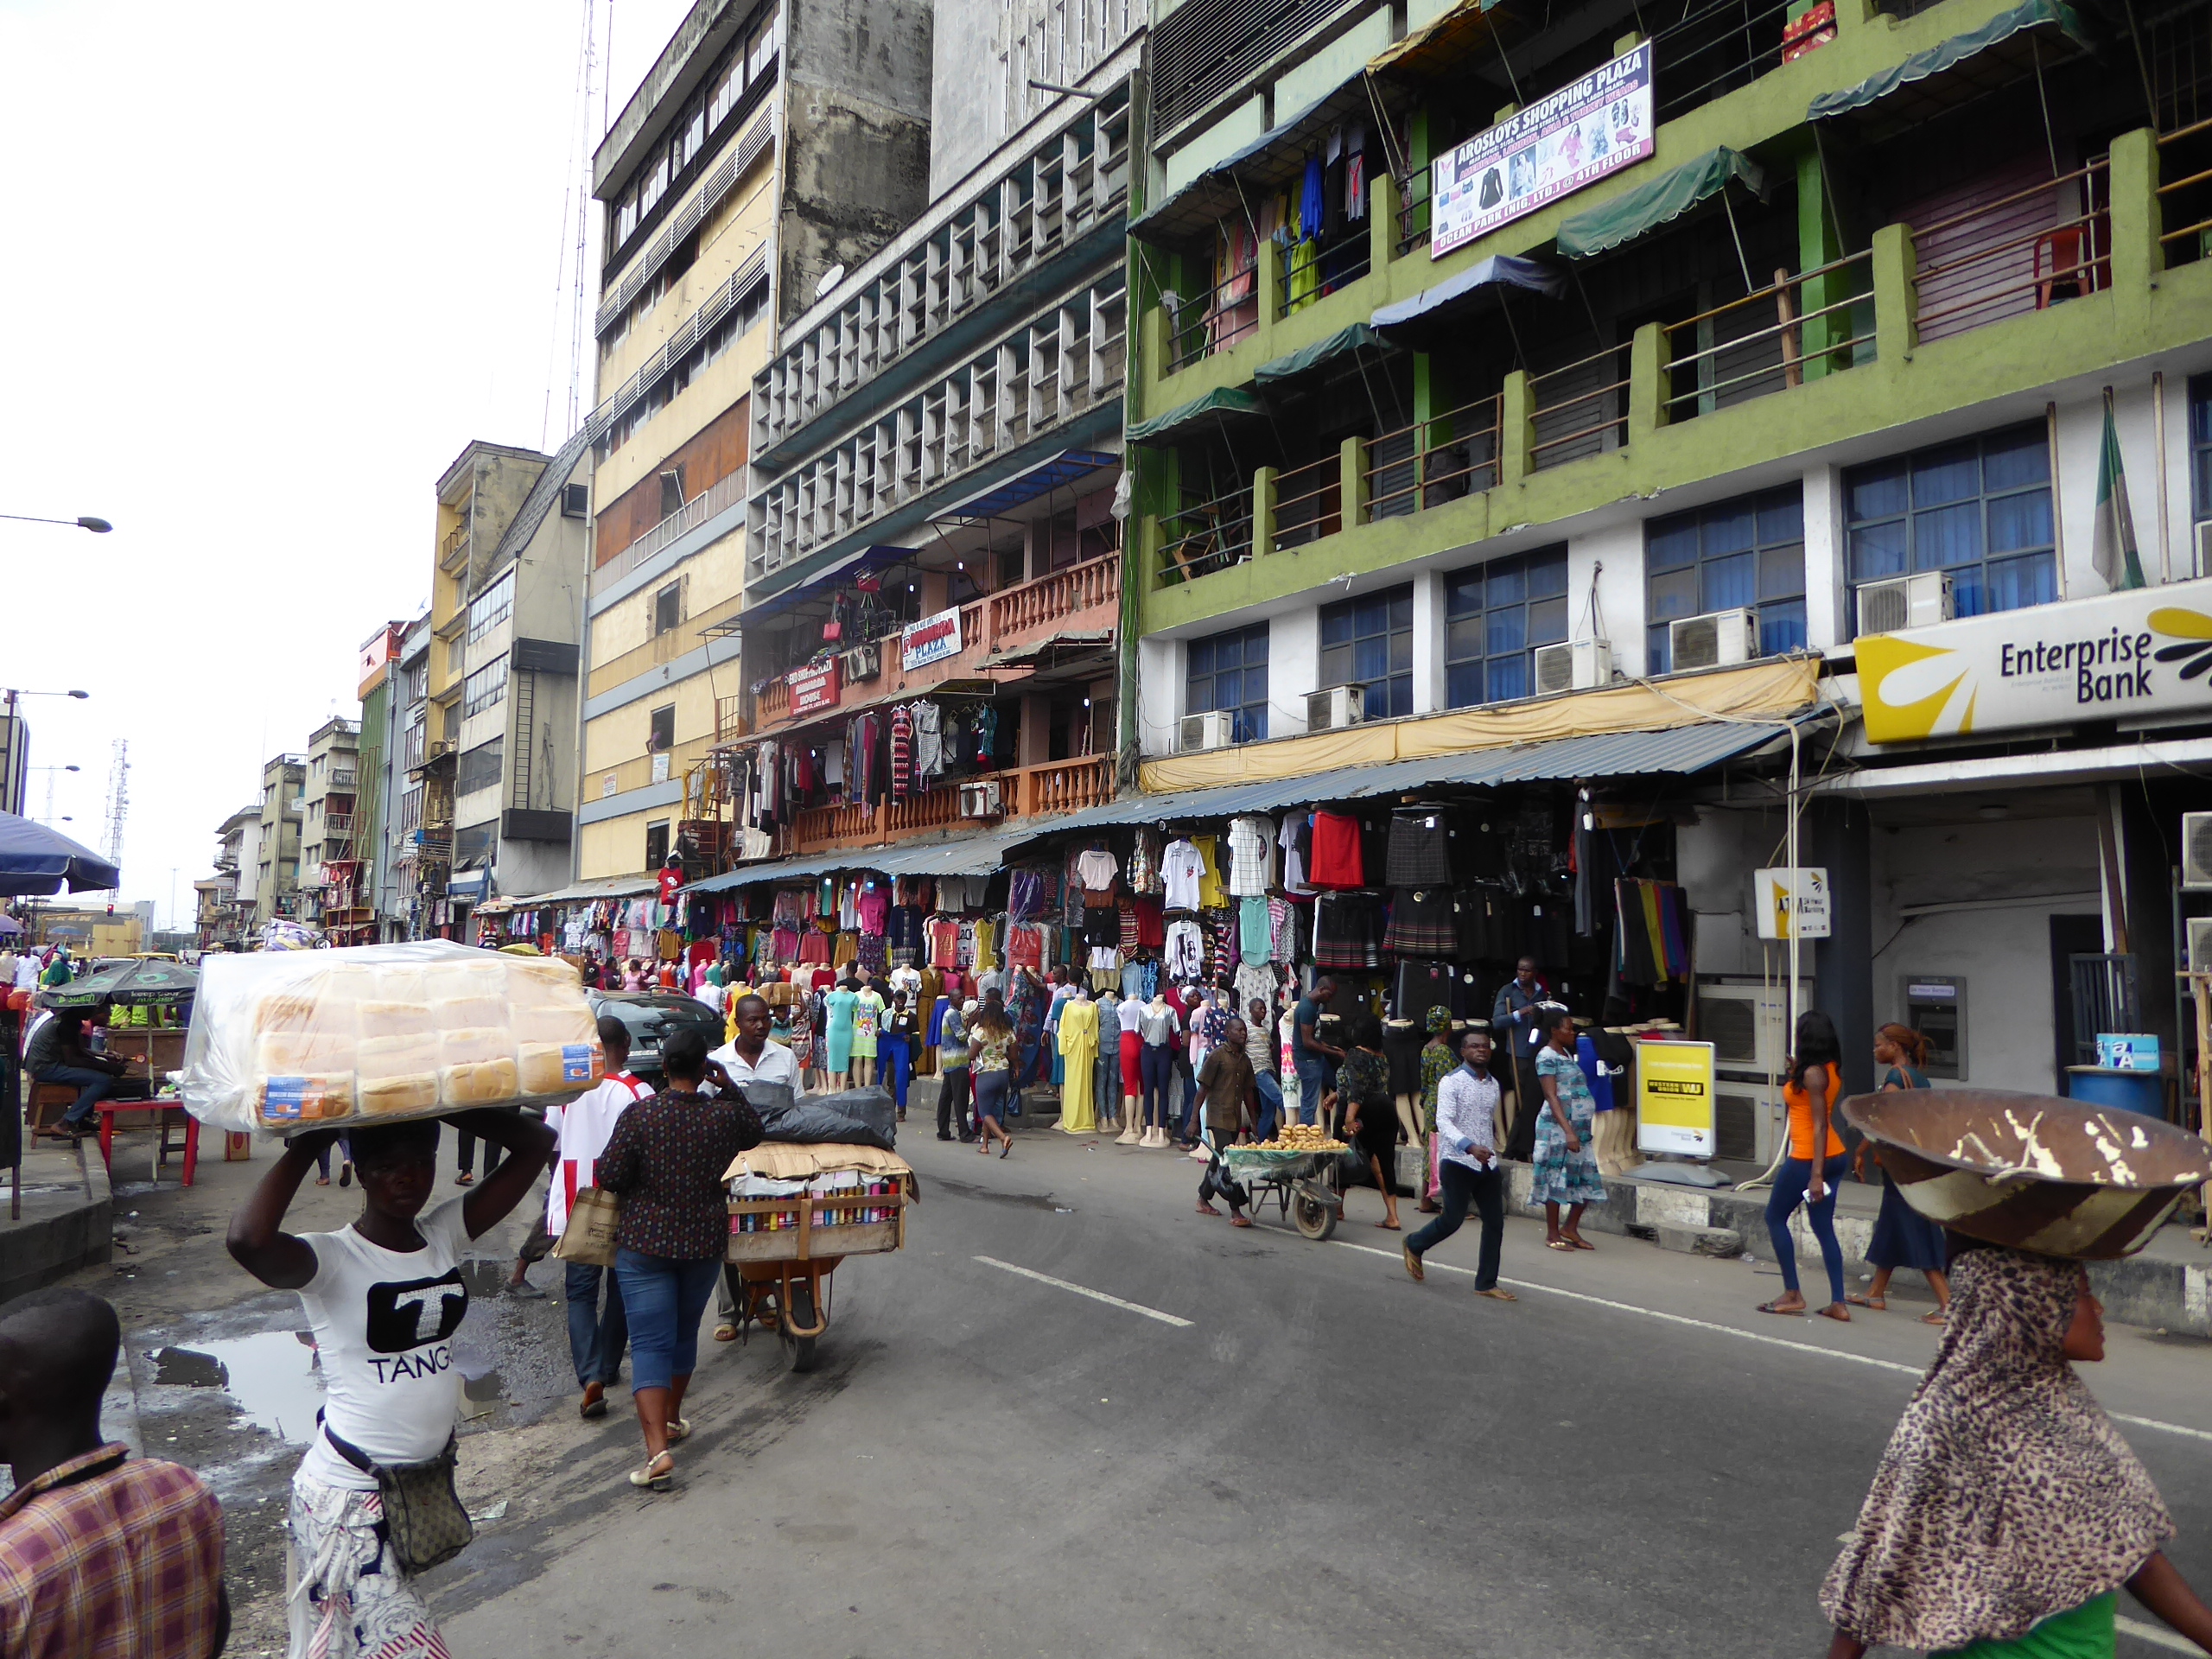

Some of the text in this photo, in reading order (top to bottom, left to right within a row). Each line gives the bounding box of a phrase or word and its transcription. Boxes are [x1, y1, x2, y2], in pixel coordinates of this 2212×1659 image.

[1458, 52, 1642, 165] AROSLOYS SHOPPING PLAZA
[1570, 96, 1605, 121] TURKEY
[1440, 224, 1472, 248] OCEAN
[1473, 209, 1503, 232] PARK
[1562, 176, 1575, 188] @
[1576, 163, 1599, 181] 4TH
[1602, 143, 1641, 170] FLOOR
[916, 637, 946, 658] PLAZA
[2000, 626, 2152, 677] Enterprise
[2077, 659, 2152, 703] Bank
[367, 1345, 454, 1383] TANG
